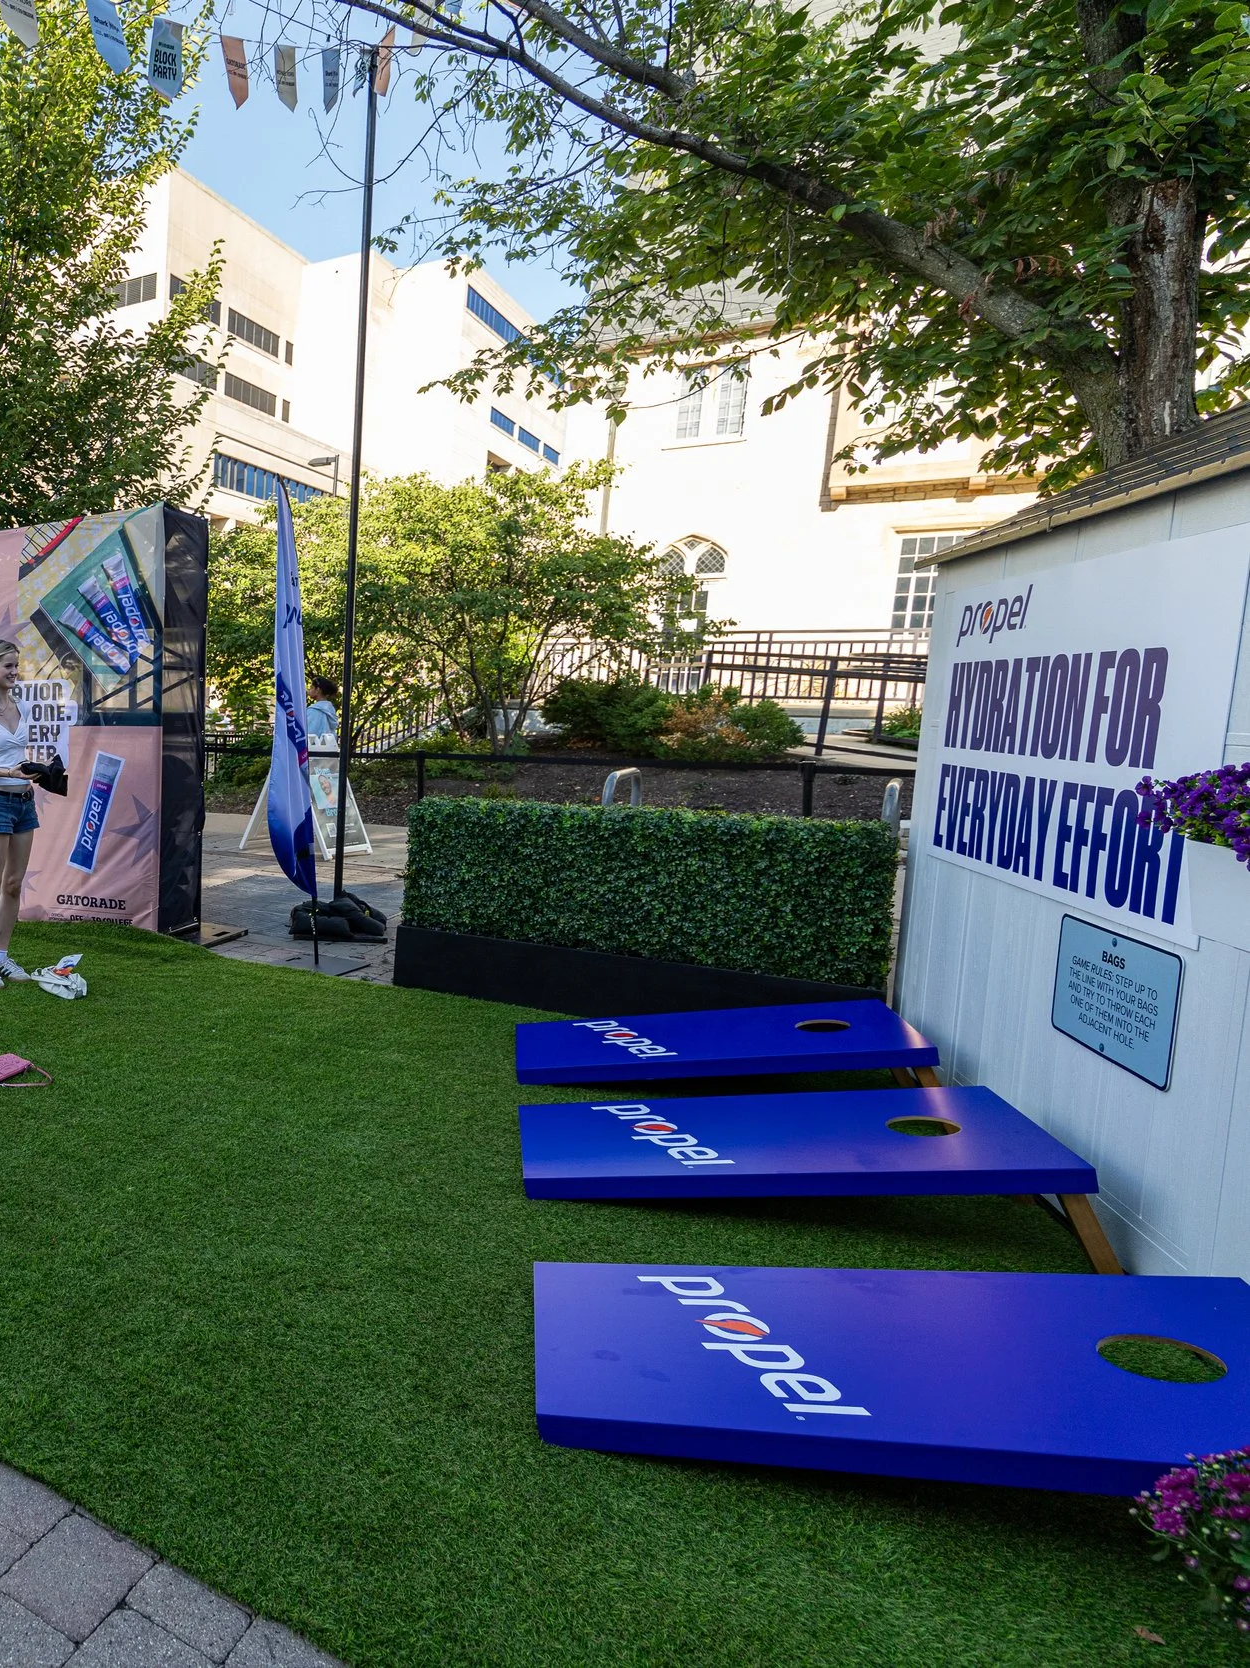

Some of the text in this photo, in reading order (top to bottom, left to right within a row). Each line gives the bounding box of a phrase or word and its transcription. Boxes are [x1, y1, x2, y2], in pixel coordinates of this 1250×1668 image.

[153, 64, 177, 80] PARTY
[154, 49, 176, 66] BLOCK
[956, 584, 1034, 647] propel
[11, 682, 63, 702] ATION
[32, 704, 72, 722] ONE.
[944, 646, 1169, 770] HYDRATION FOR
[28, 725, 60, 742] ERY
[80, 794, 103, 852] propel
[933, 763, 1058, 882] EVERYDAY
[56, 894, 126, 910] GATORADE
[1072, 956, 1158, 1000] GAME RULES: STEP UP TO
[1102, 950, 1126, 970] BAGS
[1068, 980, 1156, 1030] AND TRY TO THROW EACH
[1070, 967, 1158, 1016] THE LINE WITH YOUR BAGS
[573, 1019, 678, 1059] propel
[1070, 994, 1150, 1042] ONE OF THEM INTO THE
[1078, 1012, 1134, 1050] ADJACENT HOLE.
[590, 1104, 736, 1168] propel
[636, 1275, 872, 1420] propel
